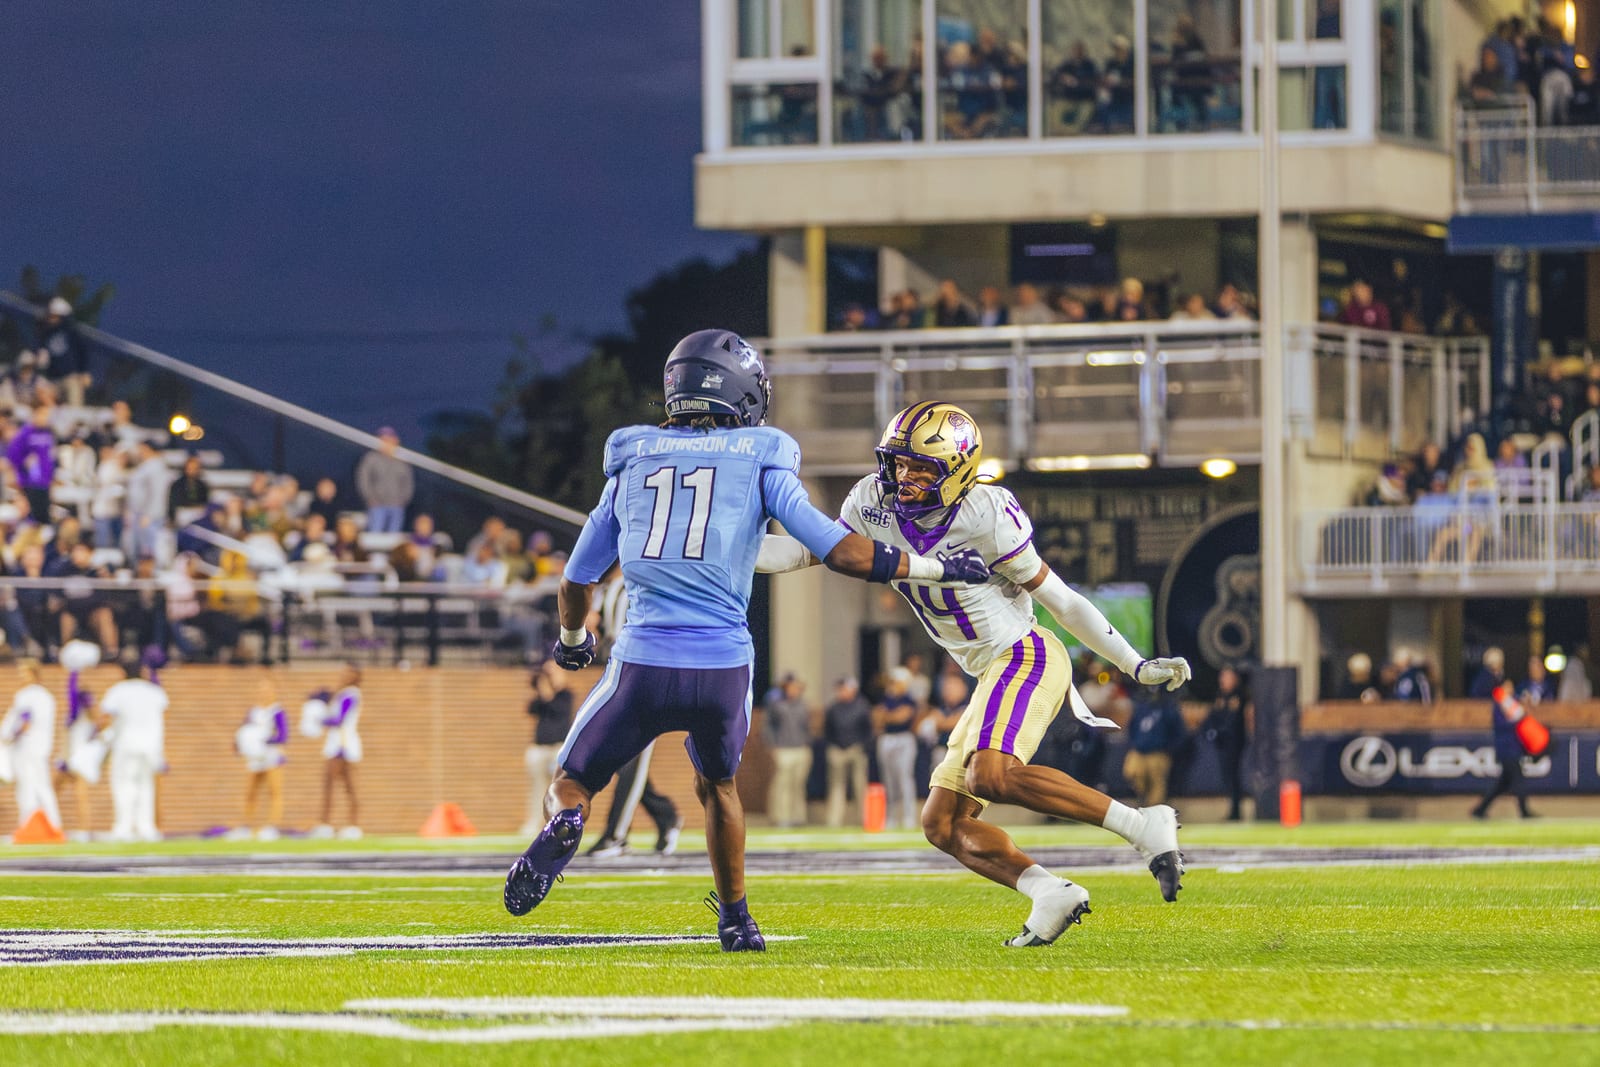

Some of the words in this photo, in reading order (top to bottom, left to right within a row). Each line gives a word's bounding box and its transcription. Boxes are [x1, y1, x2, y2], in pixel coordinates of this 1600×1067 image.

[681, 399, 710, 412] DOMINION
[636, 439, 646, 457] T.
[650, 435, 728, 453] JOHNSON
[729, 437, 756, 456] JR.
[641, 466, 717, 560] 11
[861, 505, 893, 529] SBC
[898, 581, 977, 640] 14
